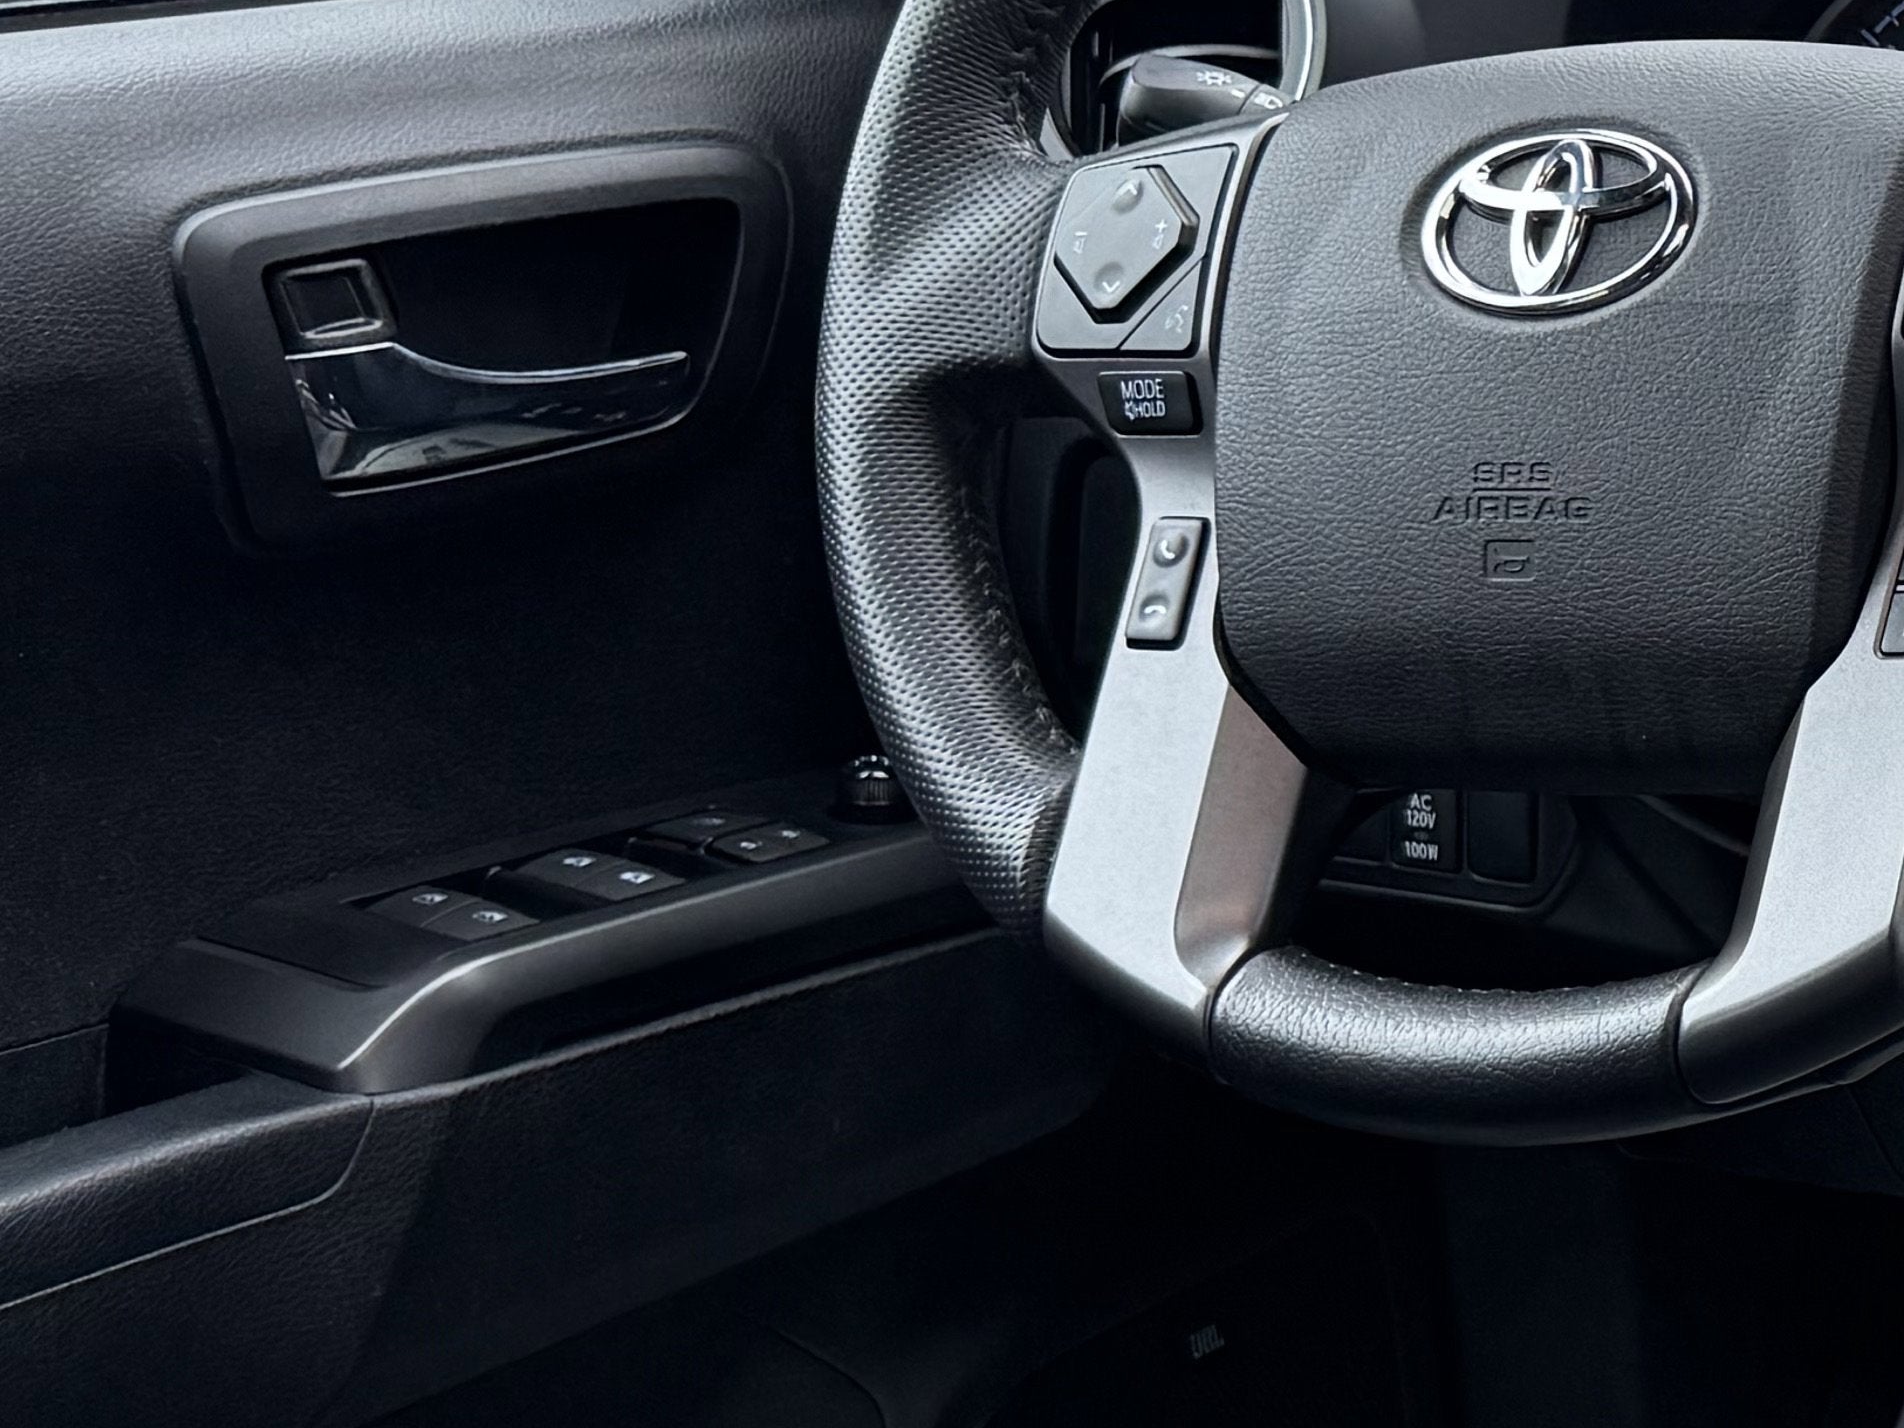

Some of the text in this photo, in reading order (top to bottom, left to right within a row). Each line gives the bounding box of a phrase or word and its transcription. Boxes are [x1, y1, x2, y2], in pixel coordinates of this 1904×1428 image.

[1121, 378, 1165, 400] MODE
[1134, 399, 1166, 418] HOLD
[1473, 461, 1553, 483] SRS
[1432, 496, 1594, 521] AIRBAG
[1406, 792, 1432, 811] AC
[1404, 808, 1437, 830] 120V
[1404, 840, 1439, 861] 100W
